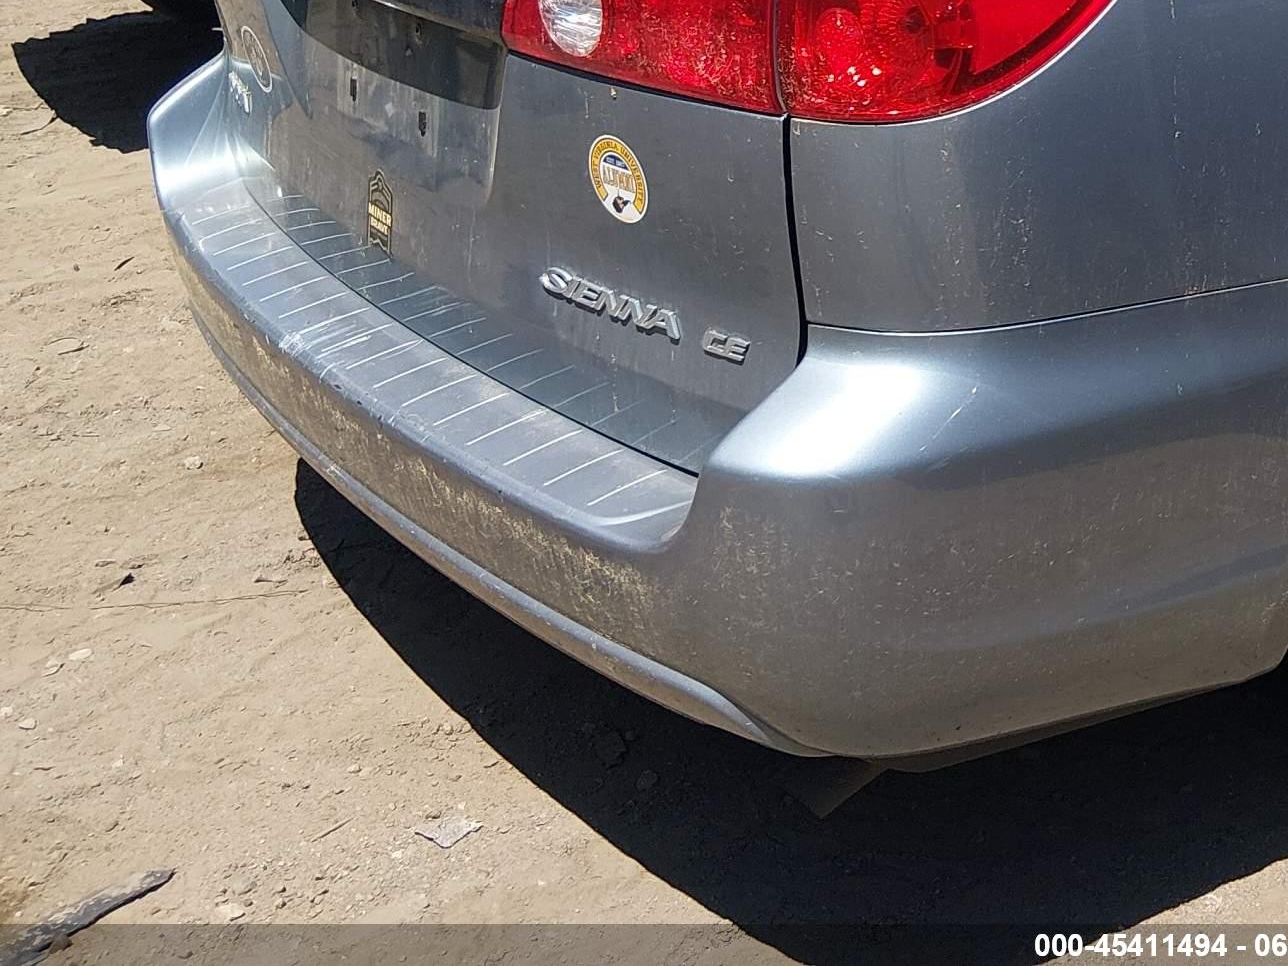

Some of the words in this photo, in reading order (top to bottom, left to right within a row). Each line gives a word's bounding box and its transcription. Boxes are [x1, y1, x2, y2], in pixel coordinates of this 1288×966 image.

[593, 140, 619, 159] VIRGINIA
[592, 160, 602, 188] WEST
[368, 201, 392, 227] MINER
[539, 266, 683, 342] SIENNA
[703, 328, 752, 365] CE
